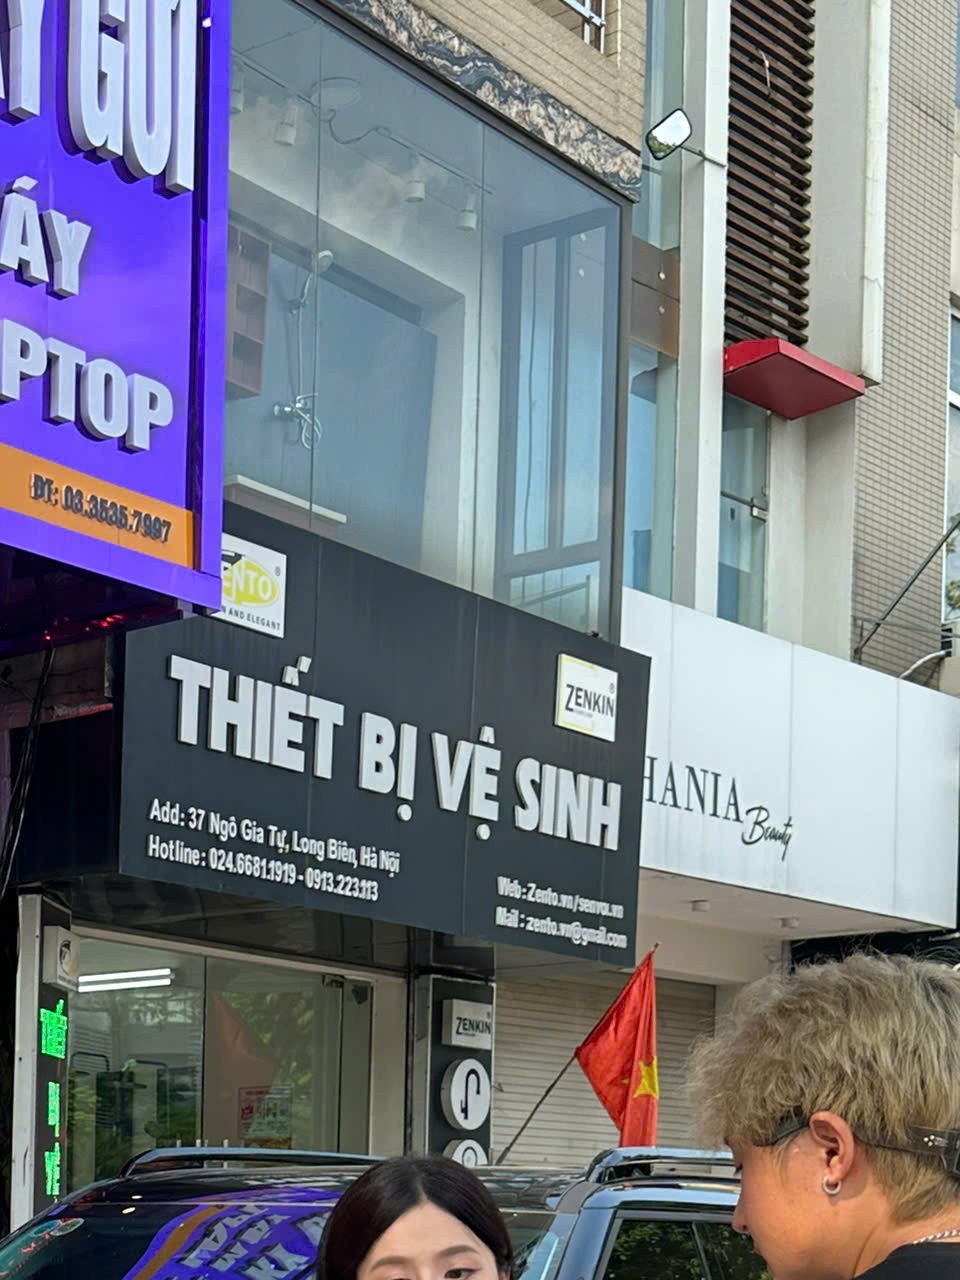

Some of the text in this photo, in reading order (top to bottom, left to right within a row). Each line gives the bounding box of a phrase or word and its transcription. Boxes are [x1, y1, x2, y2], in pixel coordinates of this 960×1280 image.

[62, 485, 171, 544] 03.3535.7997
[228, 608, 245, 619] AND
[246, 613, 281, 631] ELEGANT
[565, 684, 615, 718] ZENKIN
[169, 655, 622, 851] THIẾT BỊ VỆ SINH
[149, 798, 401, 878] Add: 37 Ngô Gia Tự, Long Biên, Hà Nội
[456, 1017, 490, 1036] ZENKIN
